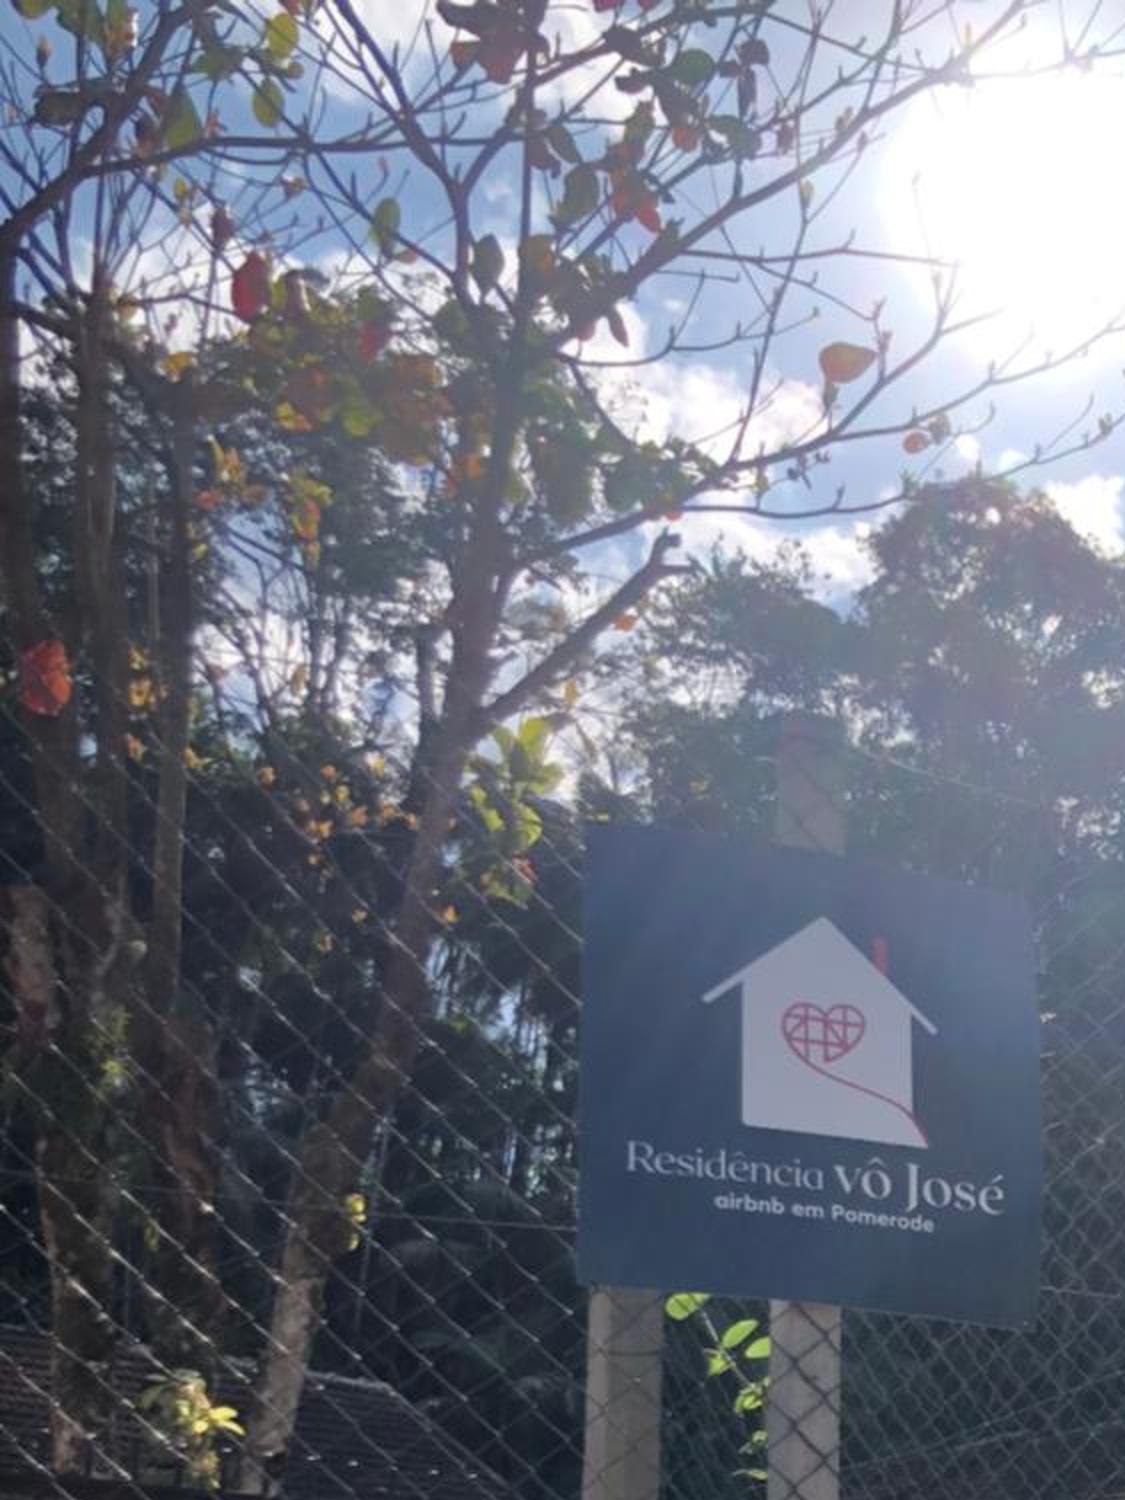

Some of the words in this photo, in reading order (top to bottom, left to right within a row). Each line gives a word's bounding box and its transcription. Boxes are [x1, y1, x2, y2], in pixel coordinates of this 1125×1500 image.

[626, 1139, 824, 1191] Residência
[833, 1156, 892, 1199] vô
[905, 1162, 1005, 1215] José
[713, 1193, 785, 1215] airbnb
[791, 1202, 825, 1220] em
[830, 1206, 936, 1234] Pomerode
